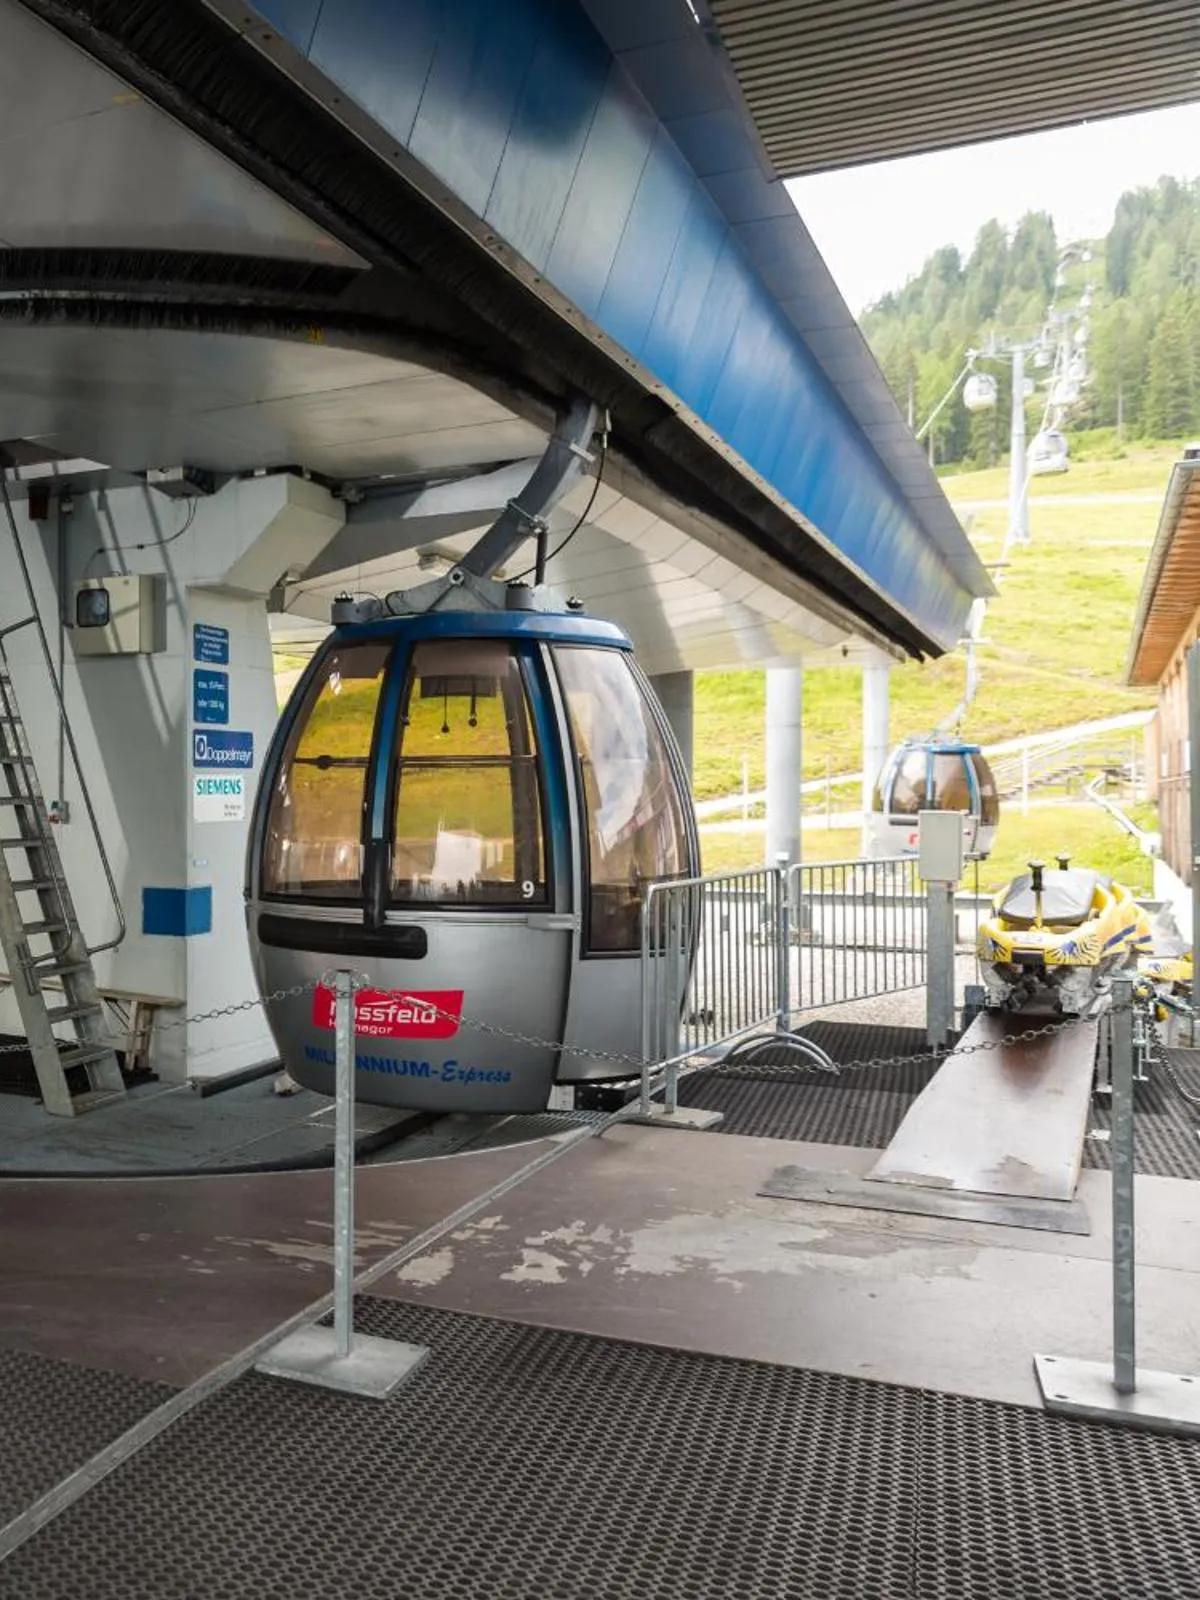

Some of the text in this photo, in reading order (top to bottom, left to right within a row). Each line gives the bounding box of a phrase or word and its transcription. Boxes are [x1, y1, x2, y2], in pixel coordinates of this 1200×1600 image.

[195, 779, 242, 795] SIEMENS
[522, 880, 535, 899] 9
[329, 1000, 437, 1023] ssfeld
[328, 1018, 393, 1035] Hagor
